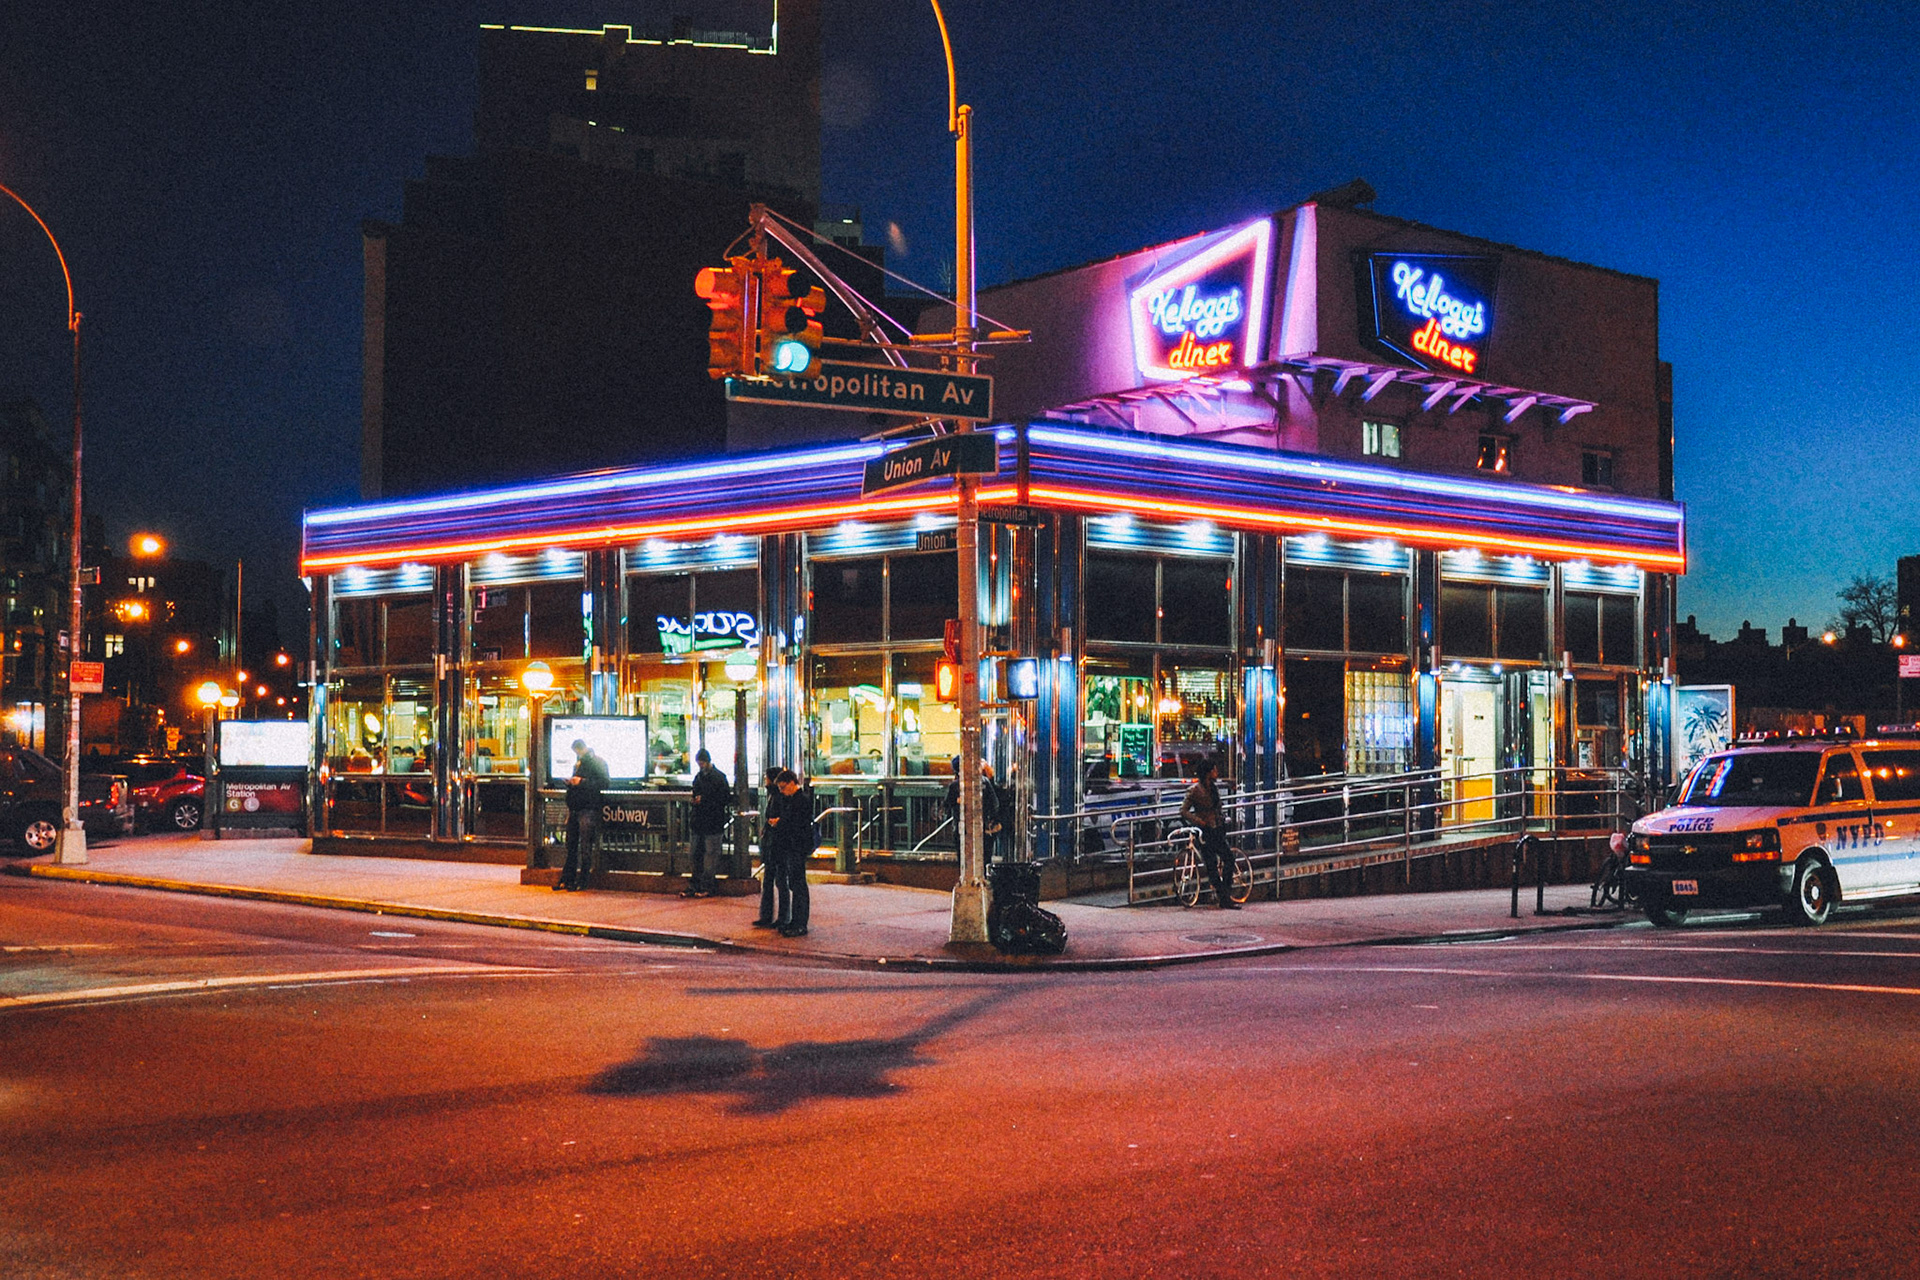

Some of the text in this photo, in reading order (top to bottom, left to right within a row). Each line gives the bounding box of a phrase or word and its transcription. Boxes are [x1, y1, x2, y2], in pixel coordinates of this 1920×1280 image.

[1168, 330, 1233, 368] diner
[1412, 316, 1477, 374] diner
[942, 381, 975, 406] Av
[884, 448, 952, 482] Union Av
[917, 530, 947, 551] Union
[225, 783, 292, 791] Metropolitan Av
[226, 790, 256, 798] Station
[229, 799, 239, 809] G
[602, 805, 648, 827] Subway
[1668, 823, 1715, 832] POLICE
[1836, 822, 1885, 851] NYPD
